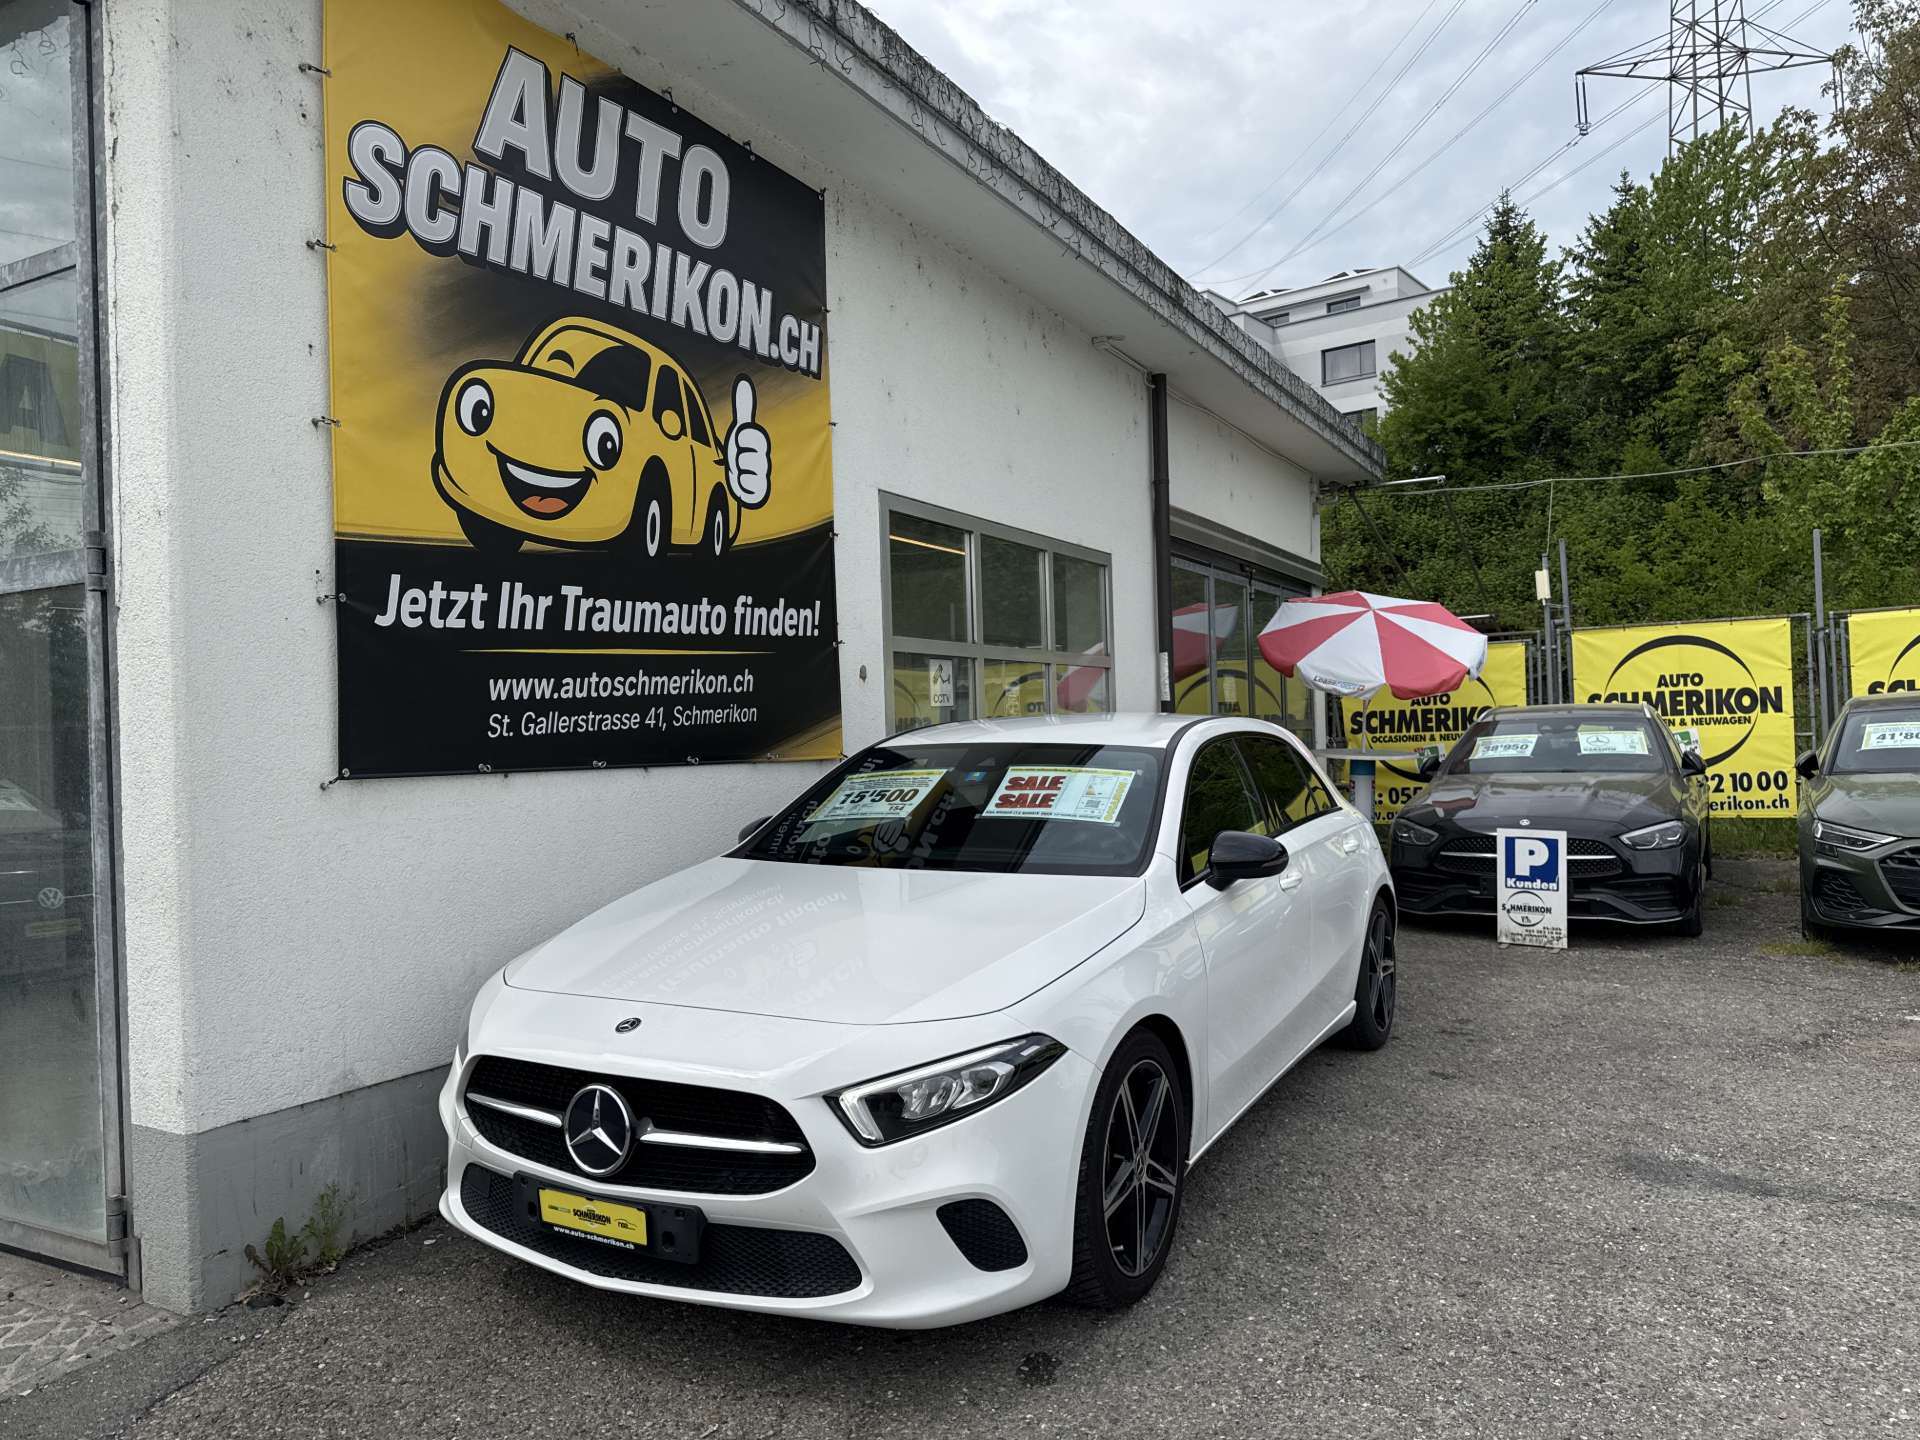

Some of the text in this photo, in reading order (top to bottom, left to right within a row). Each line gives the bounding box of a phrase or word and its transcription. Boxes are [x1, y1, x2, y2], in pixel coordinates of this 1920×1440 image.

[474, 45, 731, 250] AUTO
[344, 122, 822, 378] SCHMERIKON.CH
[374, 573, 821, 637] Jetzt Ihr Traumauto finden!
[489, 668, 754, 701] www.autoschmerikon.ch
[1656, 672, 1704, 689] AUTO
[1411, 693, 1451, 707] AUTO
[487, 704, 757, 738] St. Gallerstrasse 41, Schmerikon
[1679, 718, 1688, 727] &
[1691, 715, 1752, 726] NEUWAGEN
[1371, 733, 1426, 743] OCCASIONEN
[1429, 734, 1436, 742] &
[1005, 775, 1066, 791] SALE
[1729, 772, 1753, 792] 10
[1757, 770, 1788, 792] 00
[840, 788, 920, 804] 15'500
[995, 793, 1058, 808] SALE
[1514, 838, 1550, 877] P
[1506, 878, 1558, 890] Kunden
[1502, 903, 1552, 914] SHMERIKON
[573, 1208, 612, 1225] SCHMERIKON
